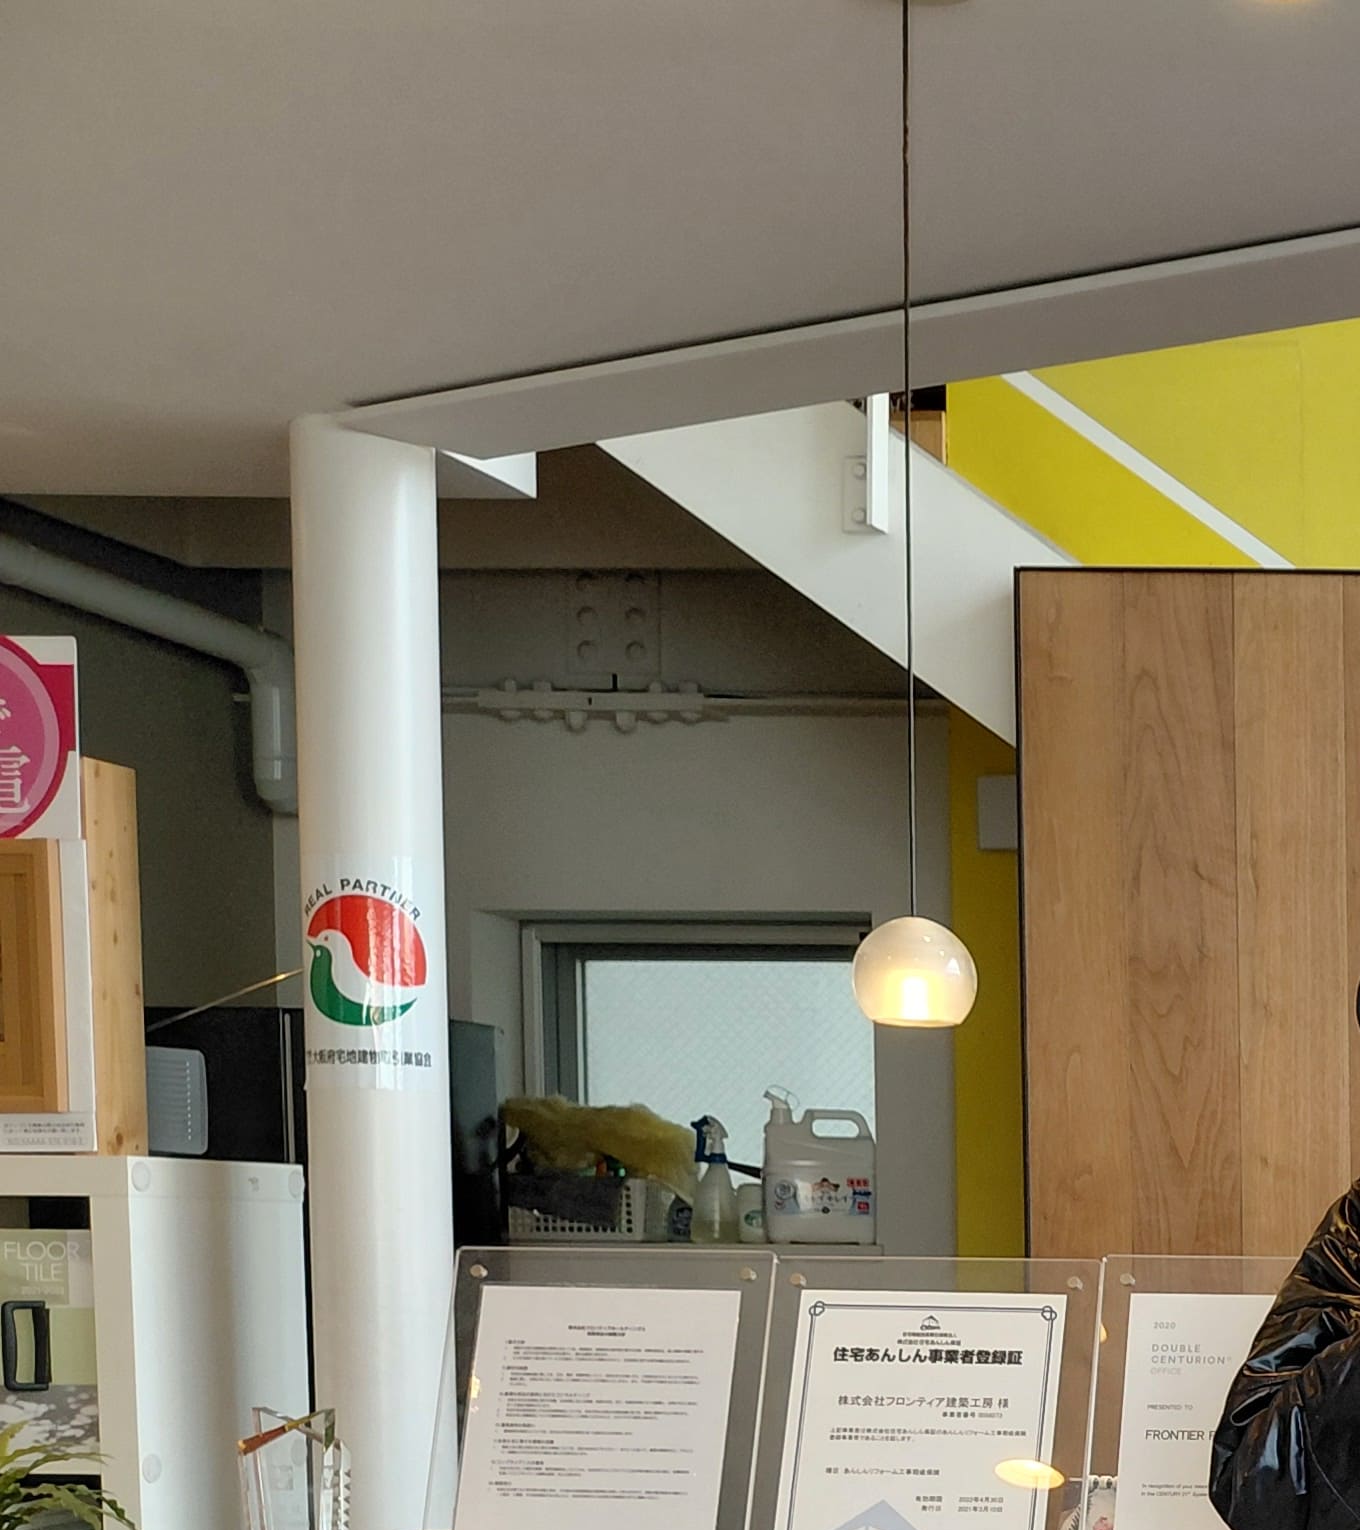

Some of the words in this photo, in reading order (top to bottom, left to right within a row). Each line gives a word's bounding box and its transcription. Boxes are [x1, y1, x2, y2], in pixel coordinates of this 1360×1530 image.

[304, 884, 333, 918] REAL
[4, 1241, 81, 1261] FLOOR
[20, 1263, 65, 1282] TILE
[833, 1347, 1024, 1366] 住宅あんしん事業者登録証
[1151, 1344, 1201, 1353] DOUBLE
[838, 1395, 993, 1409] 株式会社フロンティア建築工房
[1145, 1429, 1205, 1440] FRONTIER
